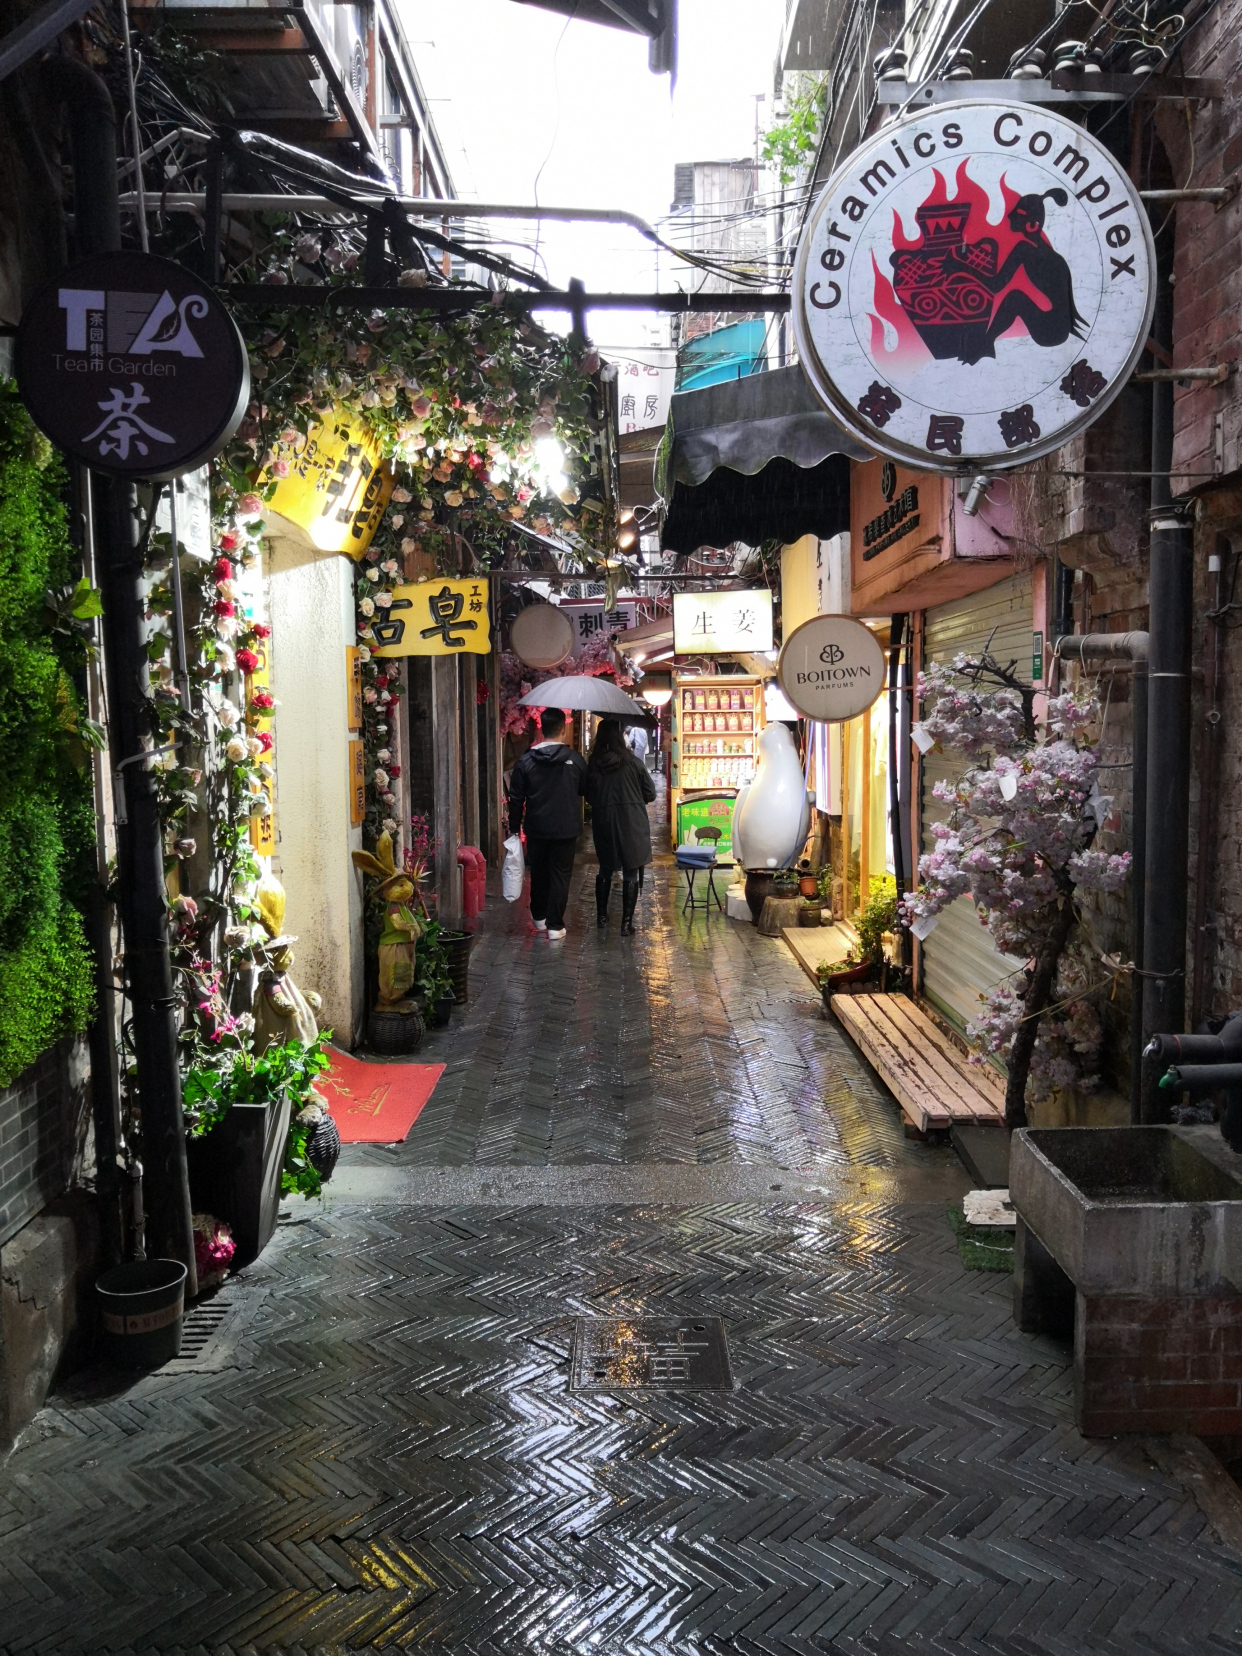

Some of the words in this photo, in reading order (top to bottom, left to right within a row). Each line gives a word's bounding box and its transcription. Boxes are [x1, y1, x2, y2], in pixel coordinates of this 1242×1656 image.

[809, 122, 963, 310] Ceramics
[993, 112, 1137, 281] Complex
[89, 312, 104, 372] 茶园集市
[52, 353, 88, 372] Tea
[108, 357, 176, 377] Garden
[81, 382, 176, 461] 茶
[469, 585, 483, 613] 工坊
[578, 611, 631, 638] 刺青
[691, 608, 756, 636] 生姜
[796, 665, 871, 685] BOITOWN
[815, 681, 854, 691] PARFUMS
